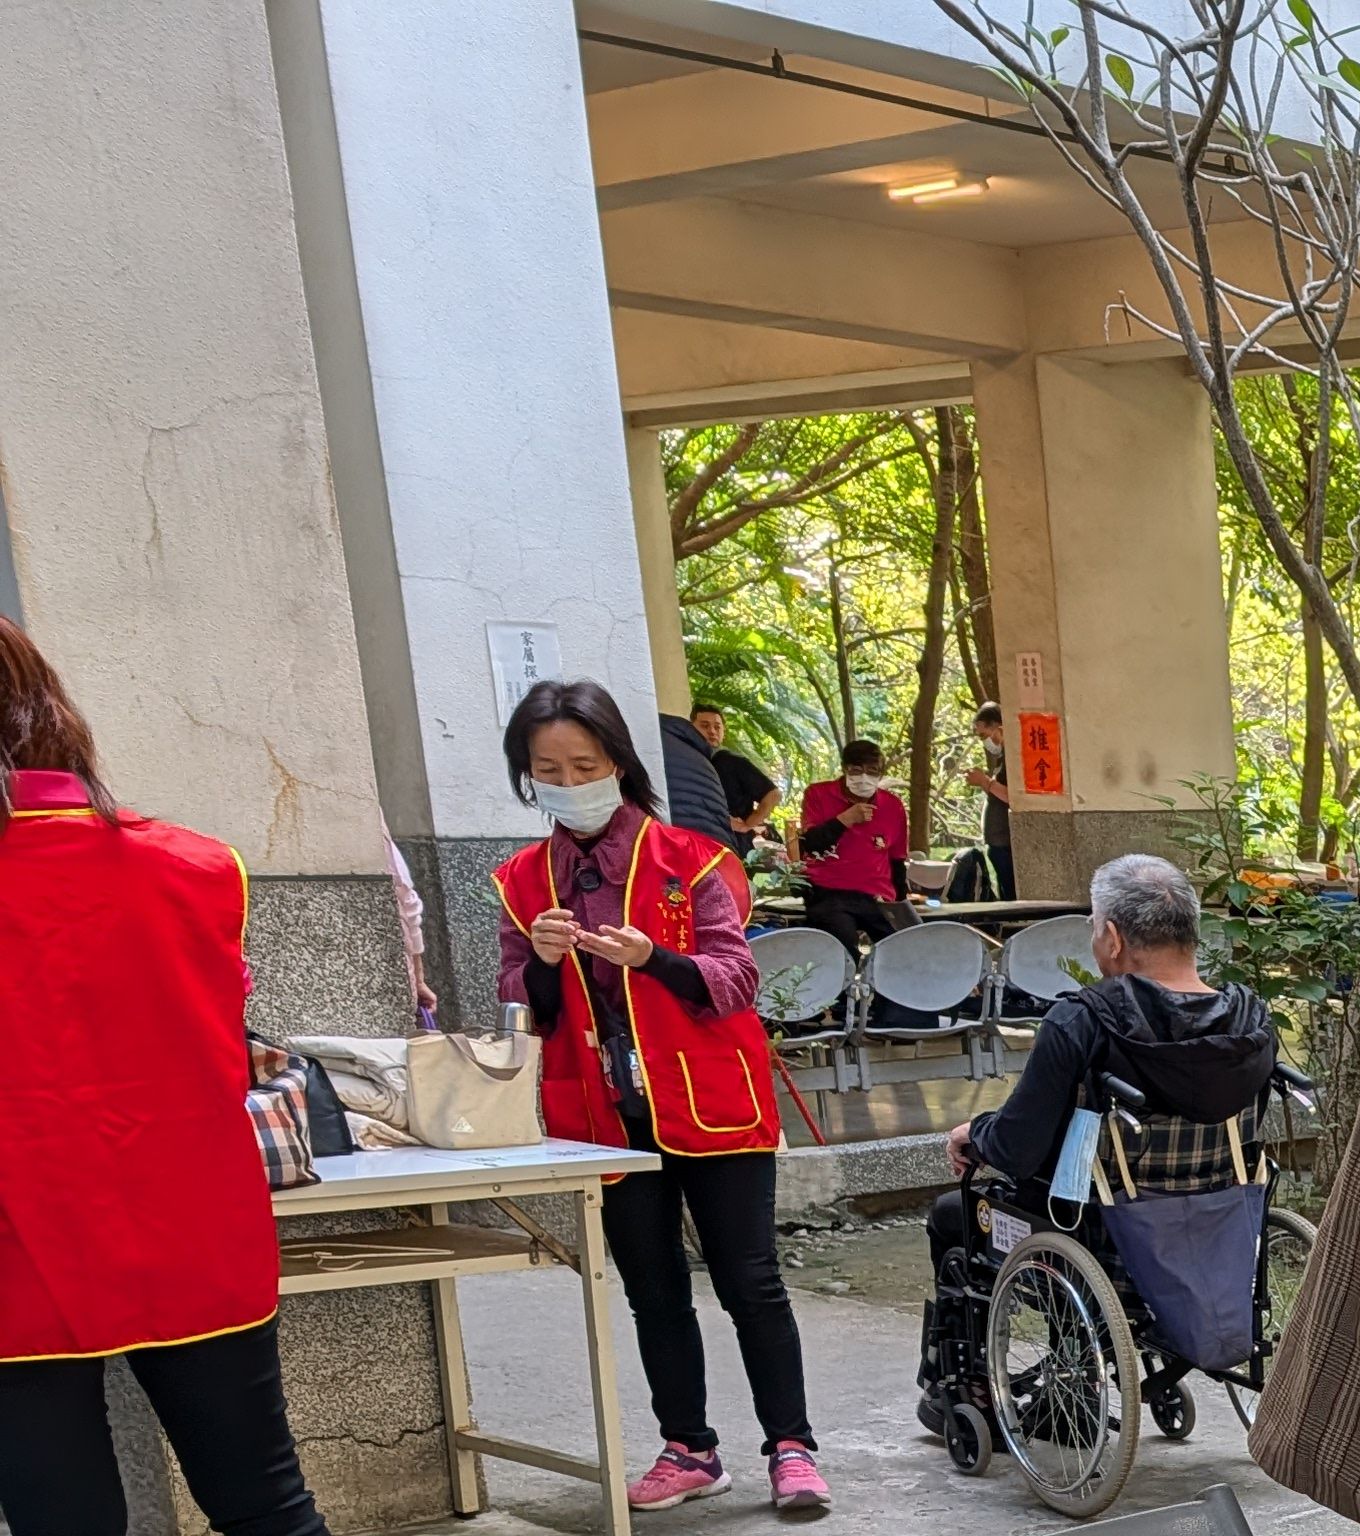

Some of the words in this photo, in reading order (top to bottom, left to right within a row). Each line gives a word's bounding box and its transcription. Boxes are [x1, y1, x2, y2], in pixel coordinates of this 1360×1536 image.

[520, 631, 539, 688] 家屬探
[1028, 725, 1051, 788] 推拿
